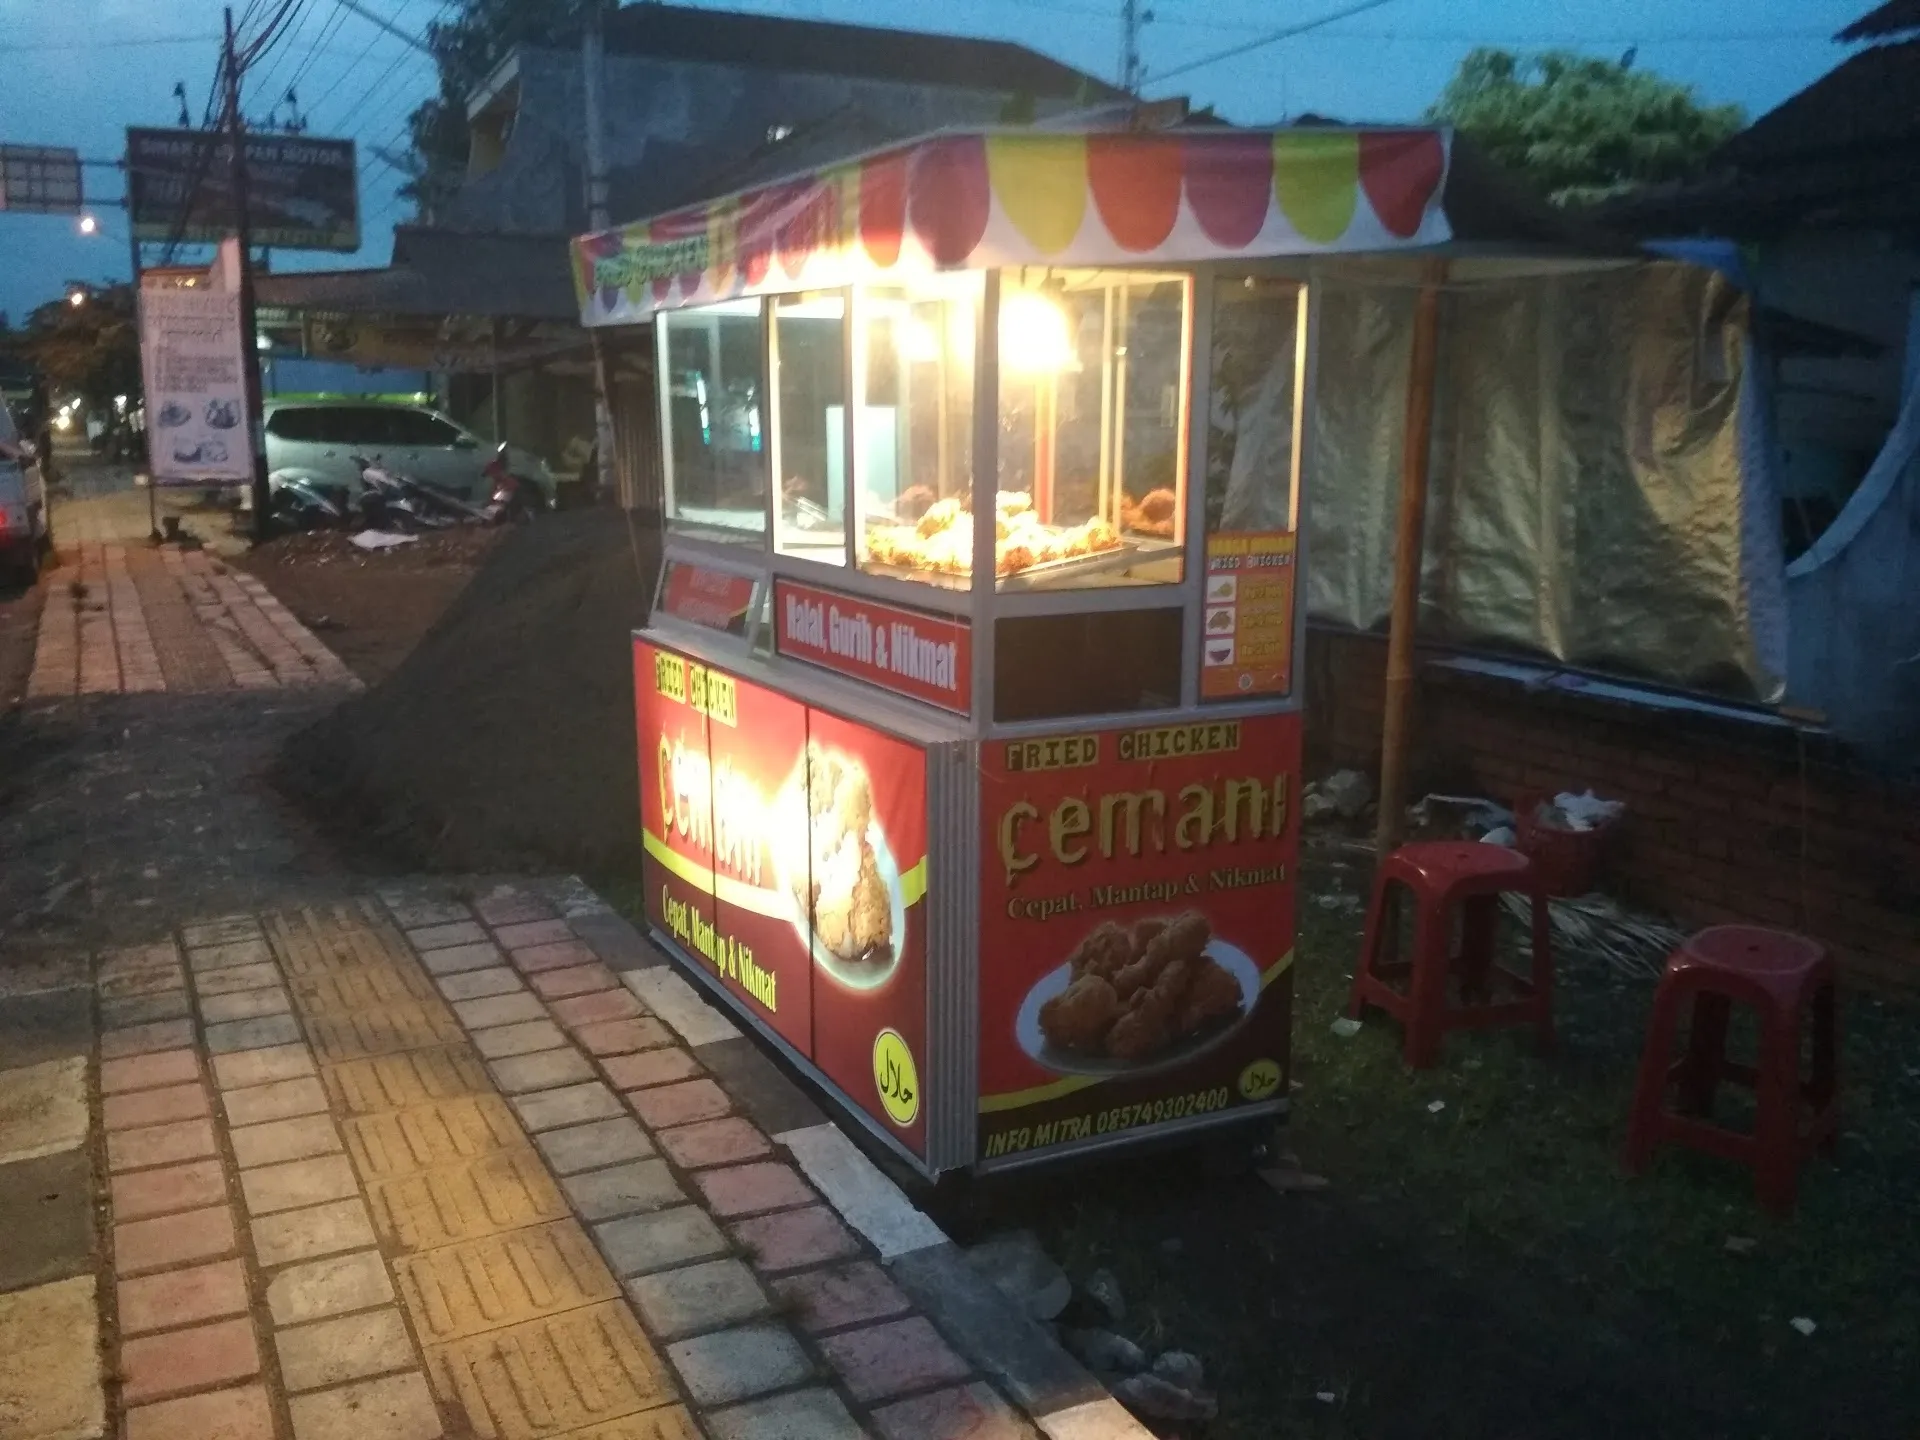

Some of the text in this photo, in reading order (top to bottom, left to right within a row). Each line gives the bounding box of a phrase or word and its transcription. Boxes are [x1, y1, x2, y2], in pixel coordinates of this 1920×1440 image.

[829, 604, 872, 664] Gurih
[874, 625, 888, 669] &
[891, 622, 957, 691] Nikmat
[655, 650, 735, 725] FRIED CHICKEN
[1007, 723, 1239, 770] FRIED CHICKEN
[1007, 863, 1286, 920] Cepat, Mantap & Nikmat
[662, 883, 691, 947] Cepat,
[728, 934, 738, 979] &
[738, 941, 777, 1013] Nikmat
[880, 1048, 913, 1104] حلال
[985, 1127, 1031, 1158] INFO
[1033, 1114, 1092, 1147] MITRA
